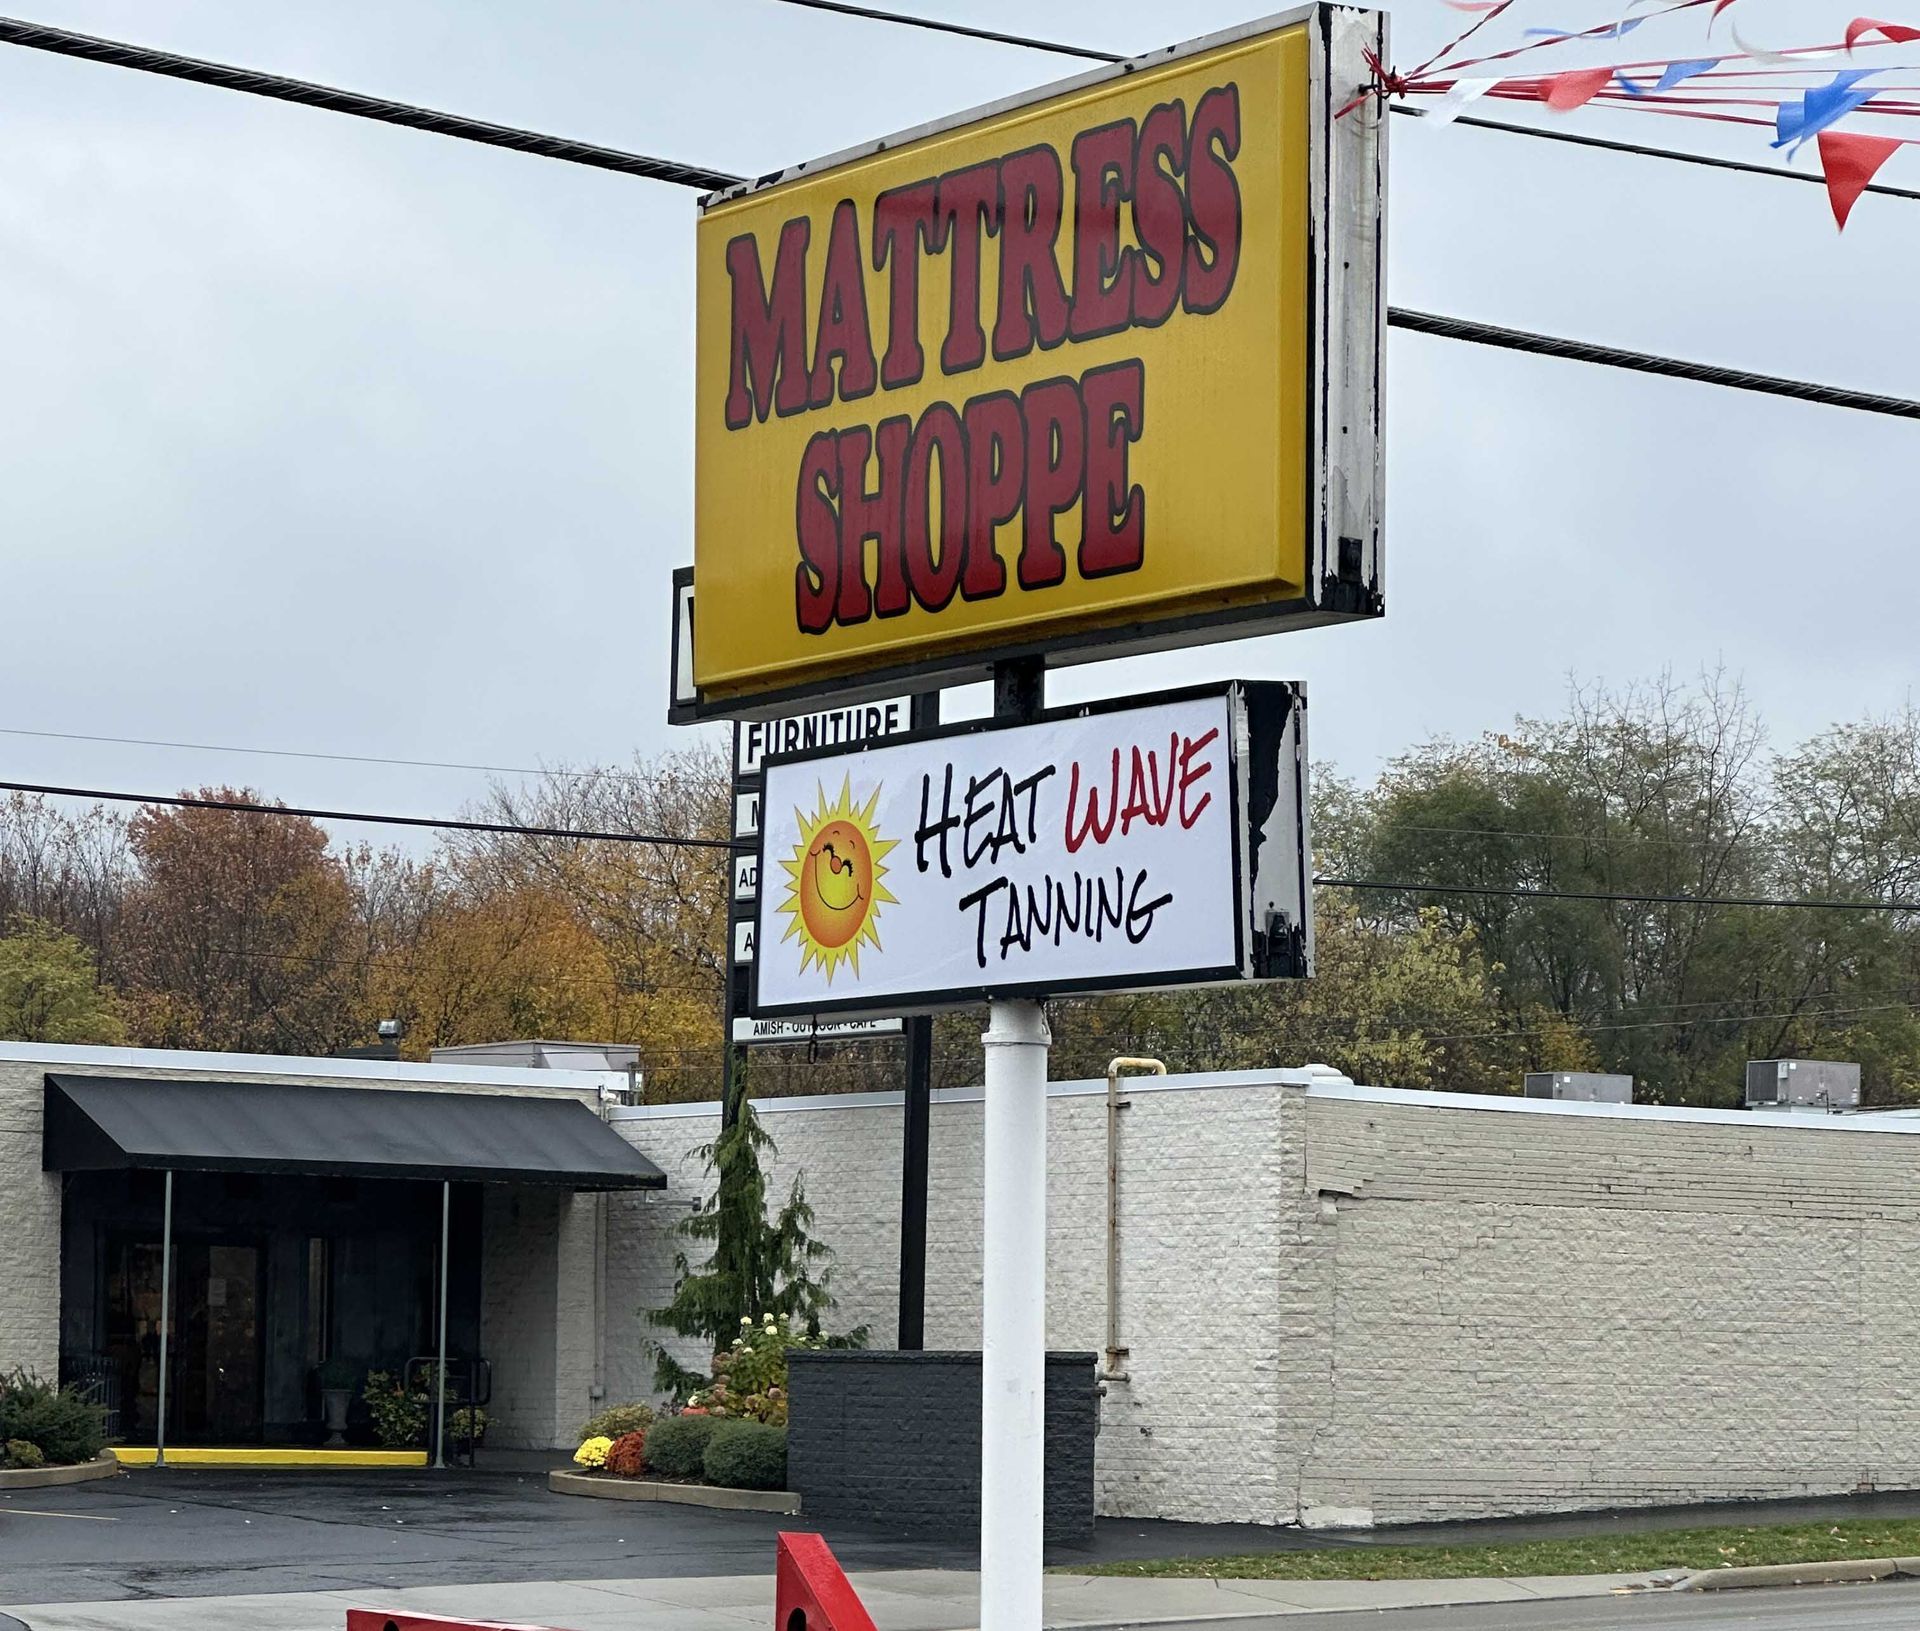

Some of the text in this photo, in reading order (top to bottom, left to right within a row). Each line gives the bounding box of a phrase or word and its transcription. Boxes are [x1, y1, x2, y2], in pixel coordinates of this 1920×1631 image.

[725, 82, 1242, 431] MATTRESS
[796, 357, 1145, 634] SHOPPE
[748, 703, 899, 763] FURNITURE
[914, 727, 1219, 878] HEAT WAVE
[959, 866, 1173, 969] TANNING
[753, 1020, 784, 1036] AMISH
